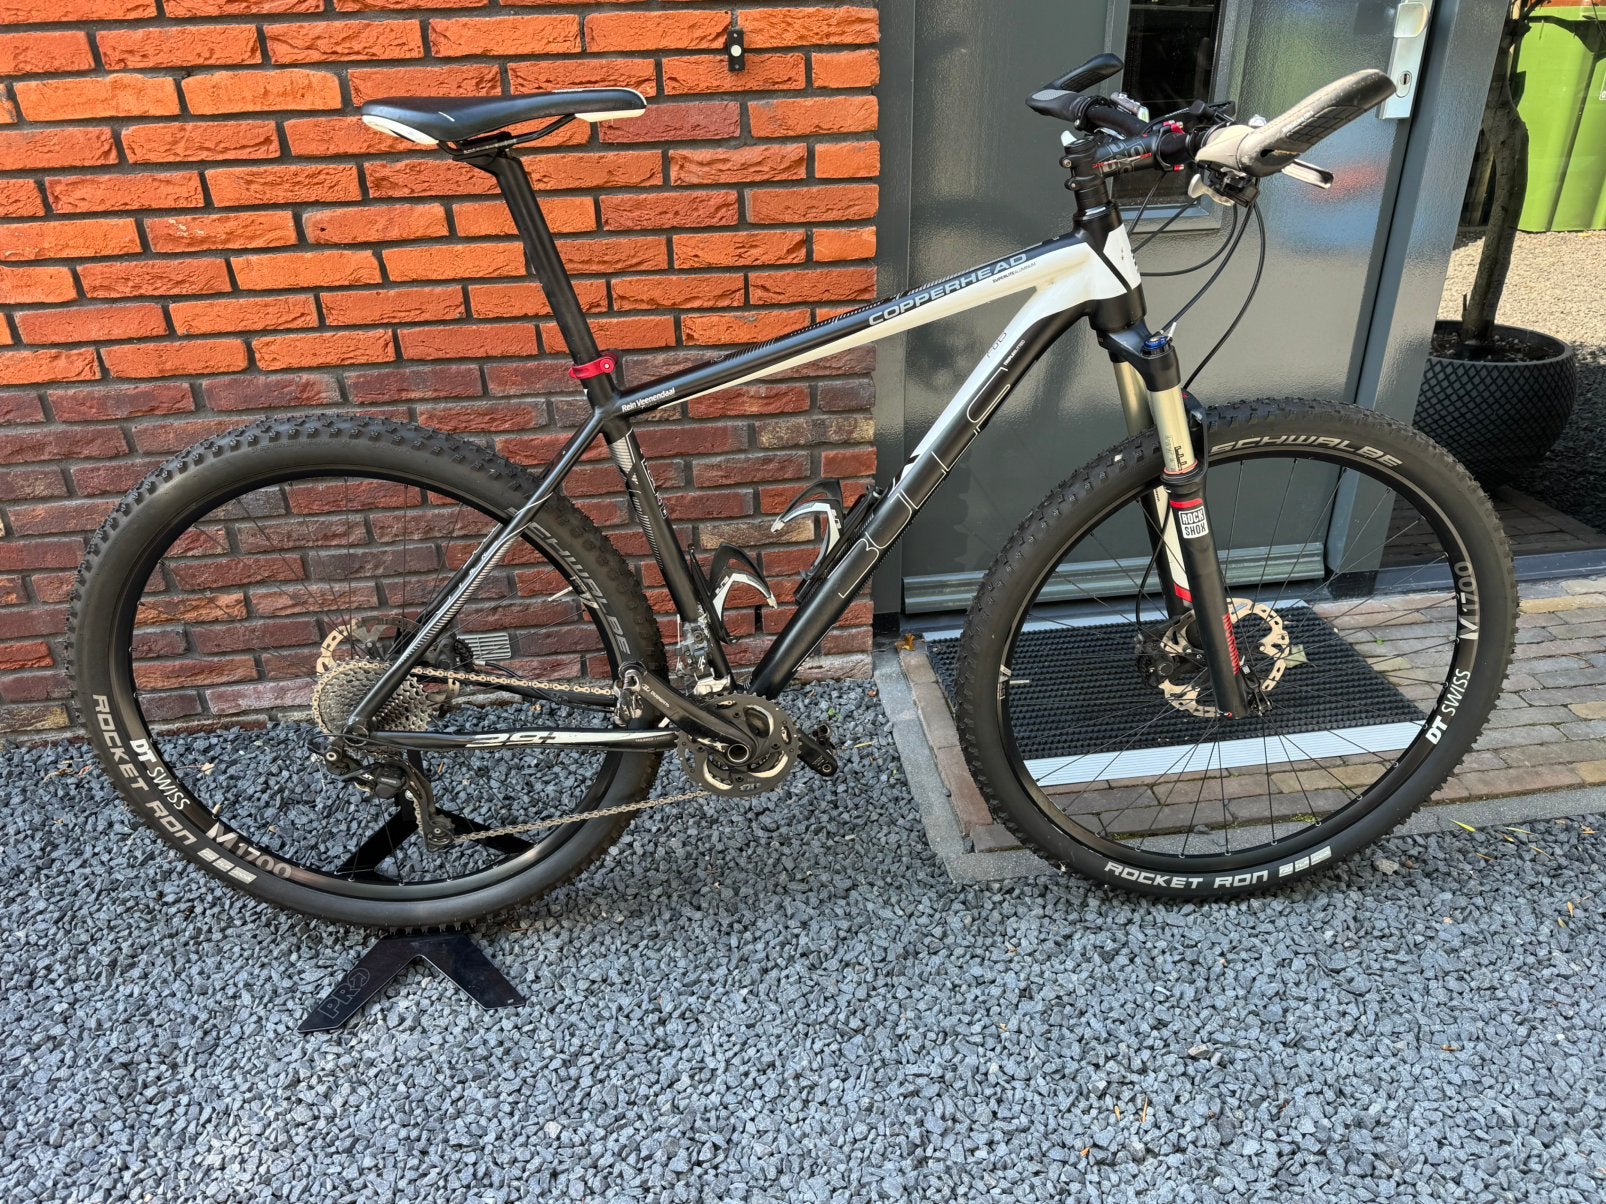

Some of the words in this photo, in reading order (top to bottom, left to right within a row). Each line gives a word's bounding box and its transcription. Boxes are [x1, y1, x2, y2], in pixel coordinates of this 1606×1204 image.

[868, 253, 1027, 326] COPPERHEAD
[621, 401, 637, 413] Rein
[636, 387, 676, 406] Veenendaal
[1209, 435, 1403, 468] SCHWALBE
[1181, 509, 1204, 525] ROCK
[1184, 521, 1207, 537] SHOX
[1425, 715, 1448, 745] DT
[1441, 668, 1471, 717] SWISS
[93, 694, 149, 791] ROCKET
[145, 800, 197, 845] RON
[130, 738, 157, 767] DT
[147, 766, 190, 811] SWISS
[1104, 861, 1203, 889] ROCKET
[1213, 869, 1269, 889] RON
